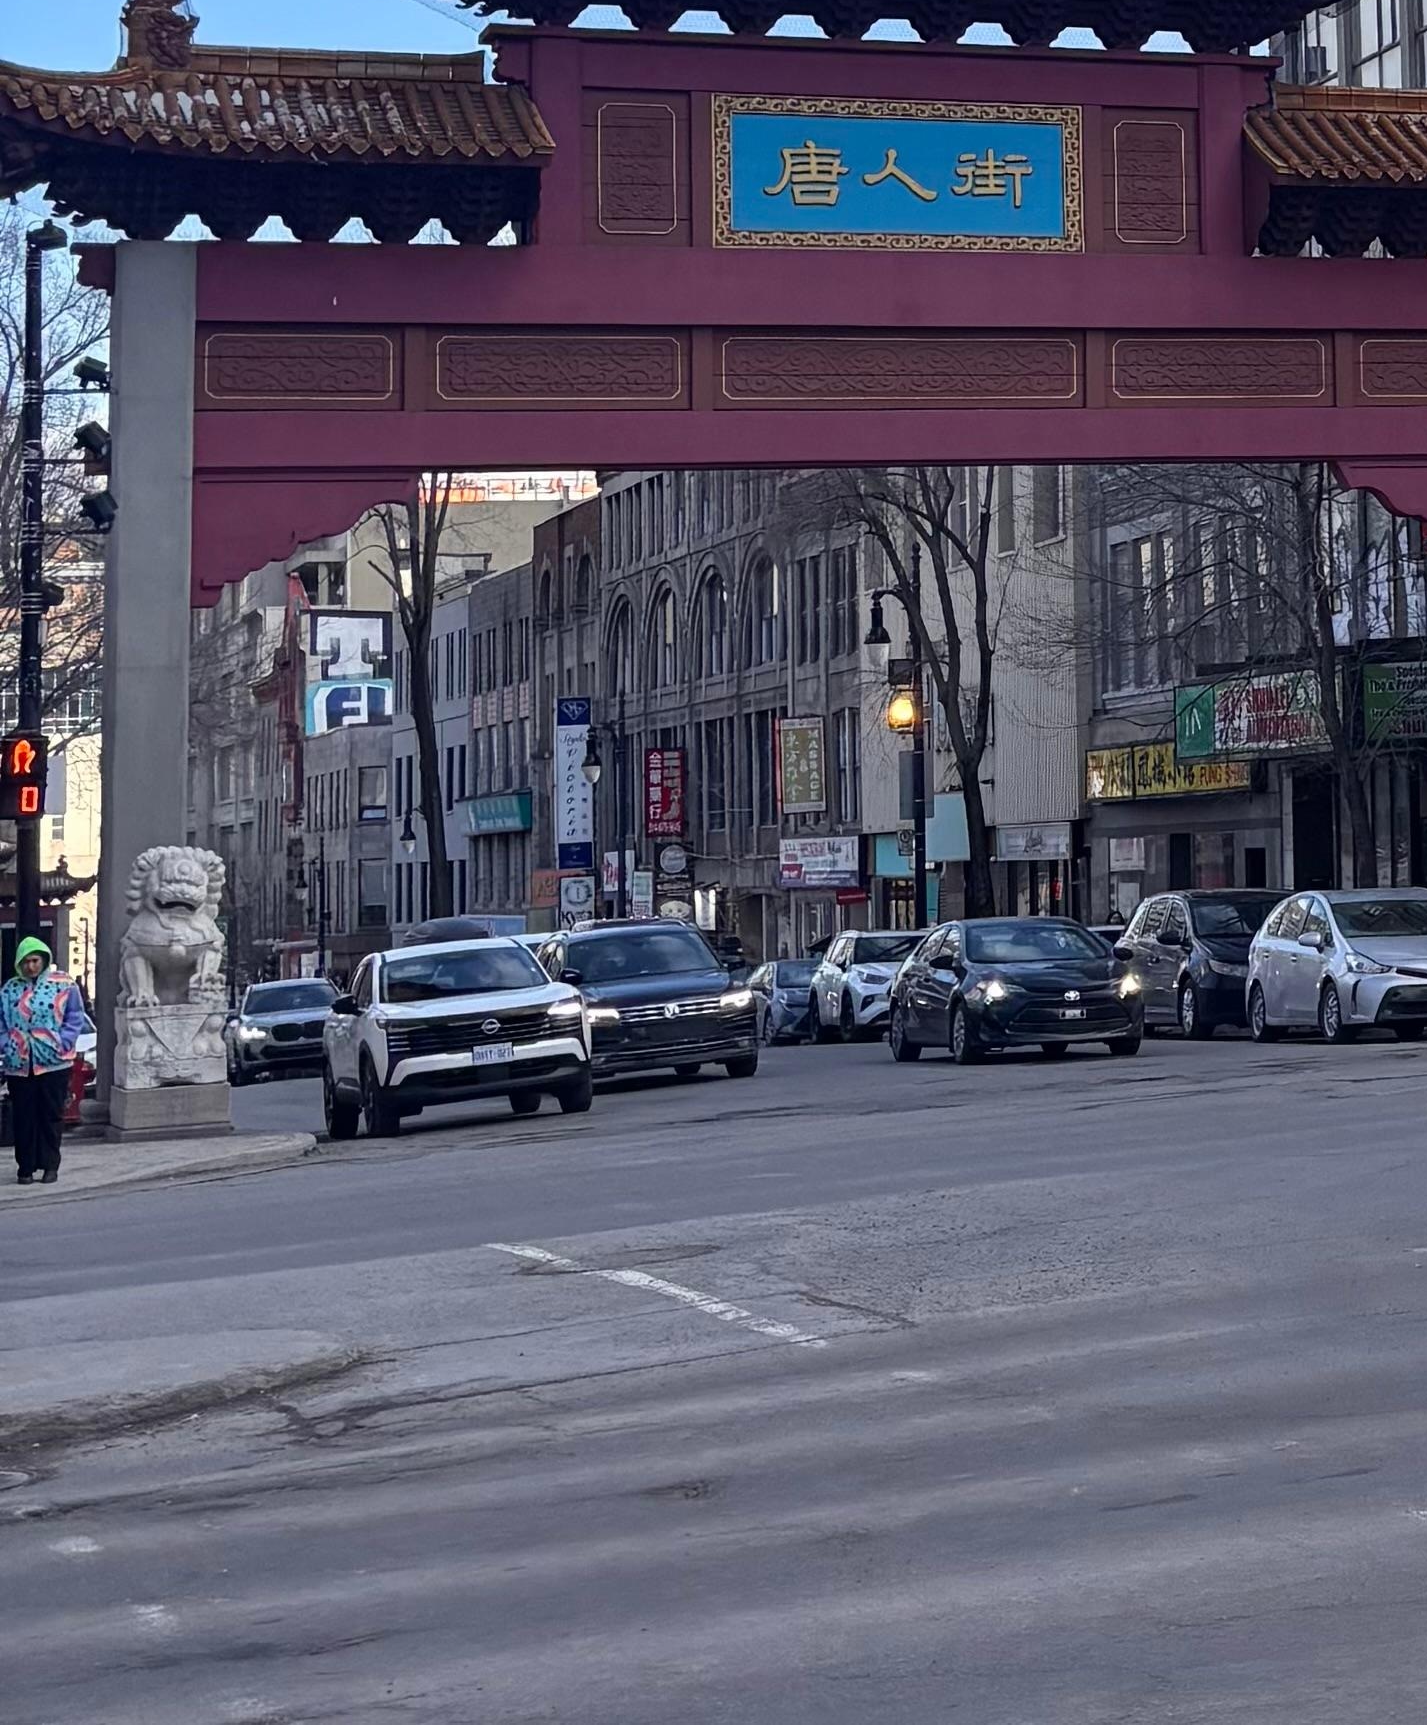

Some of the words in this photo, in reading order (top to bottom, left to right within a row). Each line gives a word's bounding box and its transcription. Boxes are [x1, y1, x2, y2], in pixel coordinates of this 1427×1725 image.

[764, 139, 1033, 208] 唐人街
[808, 729, 820, 801] MASSAGE
